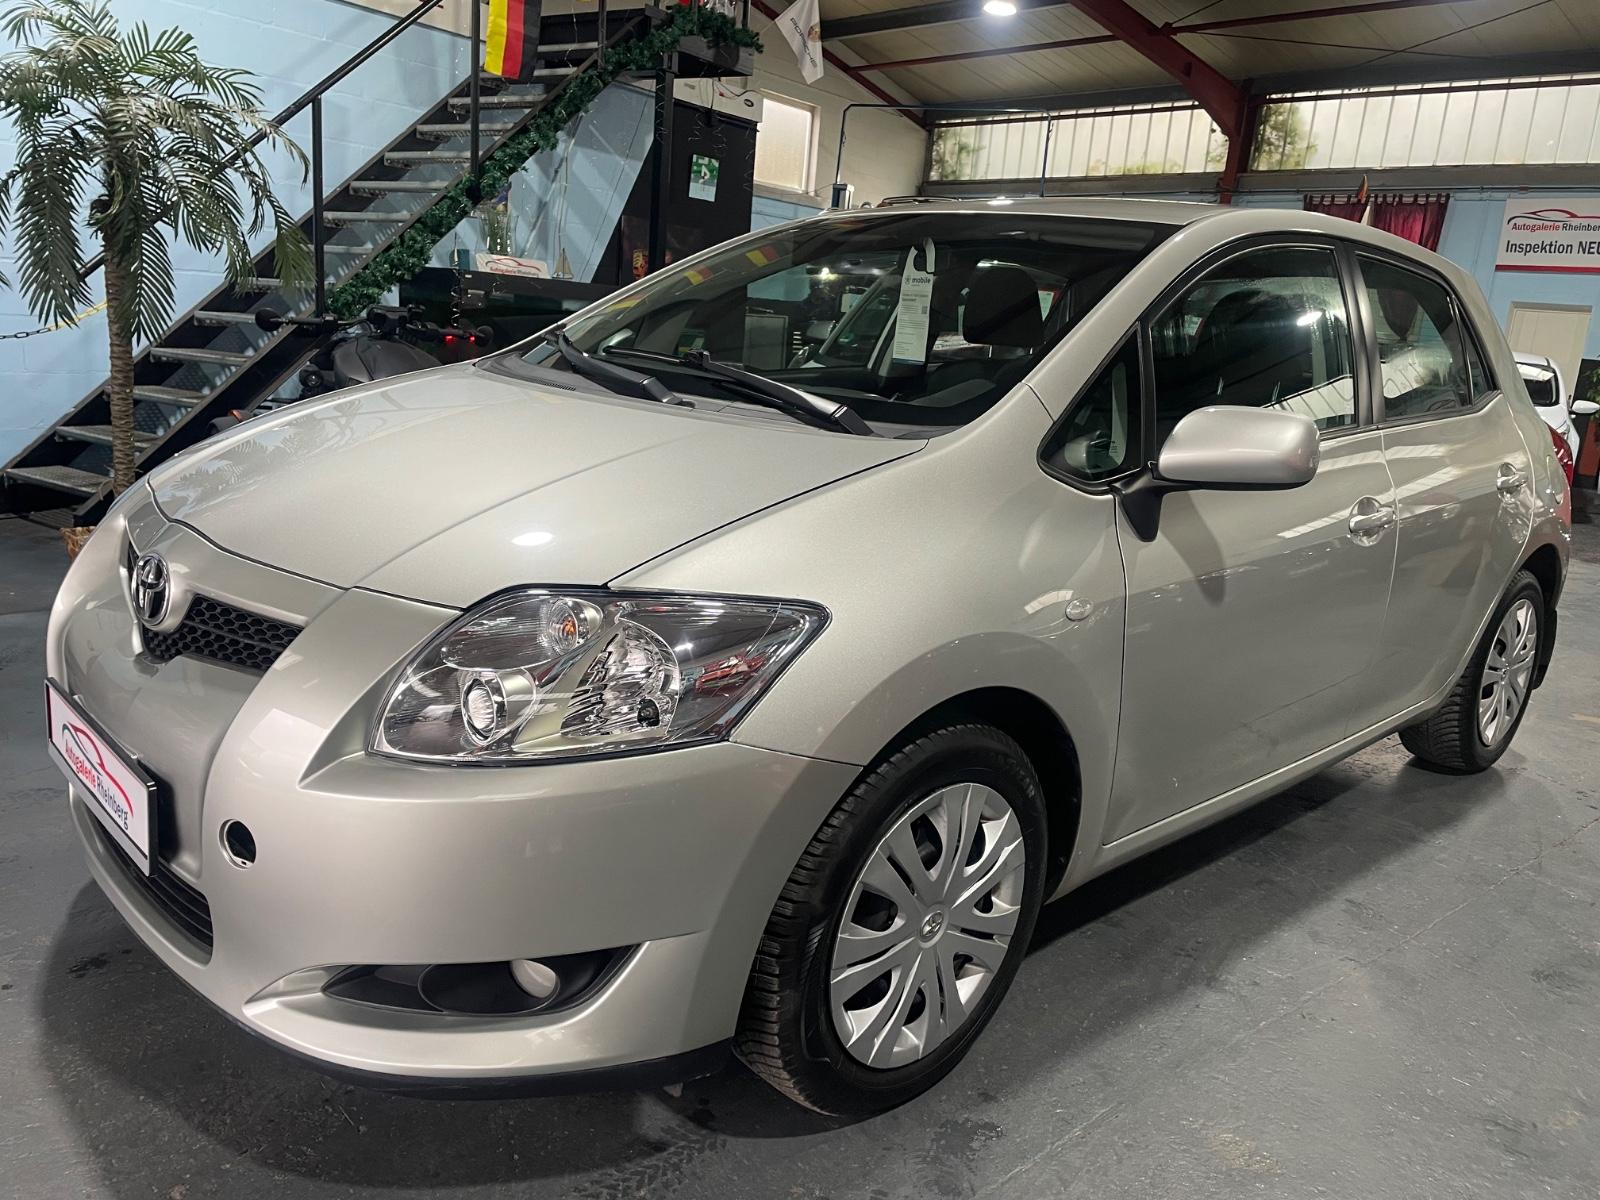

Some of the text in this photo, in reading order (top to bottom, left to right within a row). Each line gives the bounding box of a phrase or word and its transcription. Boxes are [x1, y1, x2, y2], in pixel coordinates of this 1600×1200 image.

[1511, 222, 1560, 233] Autogalerie
[1505, 240, 1574, 256] Inspektion
[911, 276, 931, 284] mobile
[65, 738, 129, 831] Autogalerie Rheinberg
